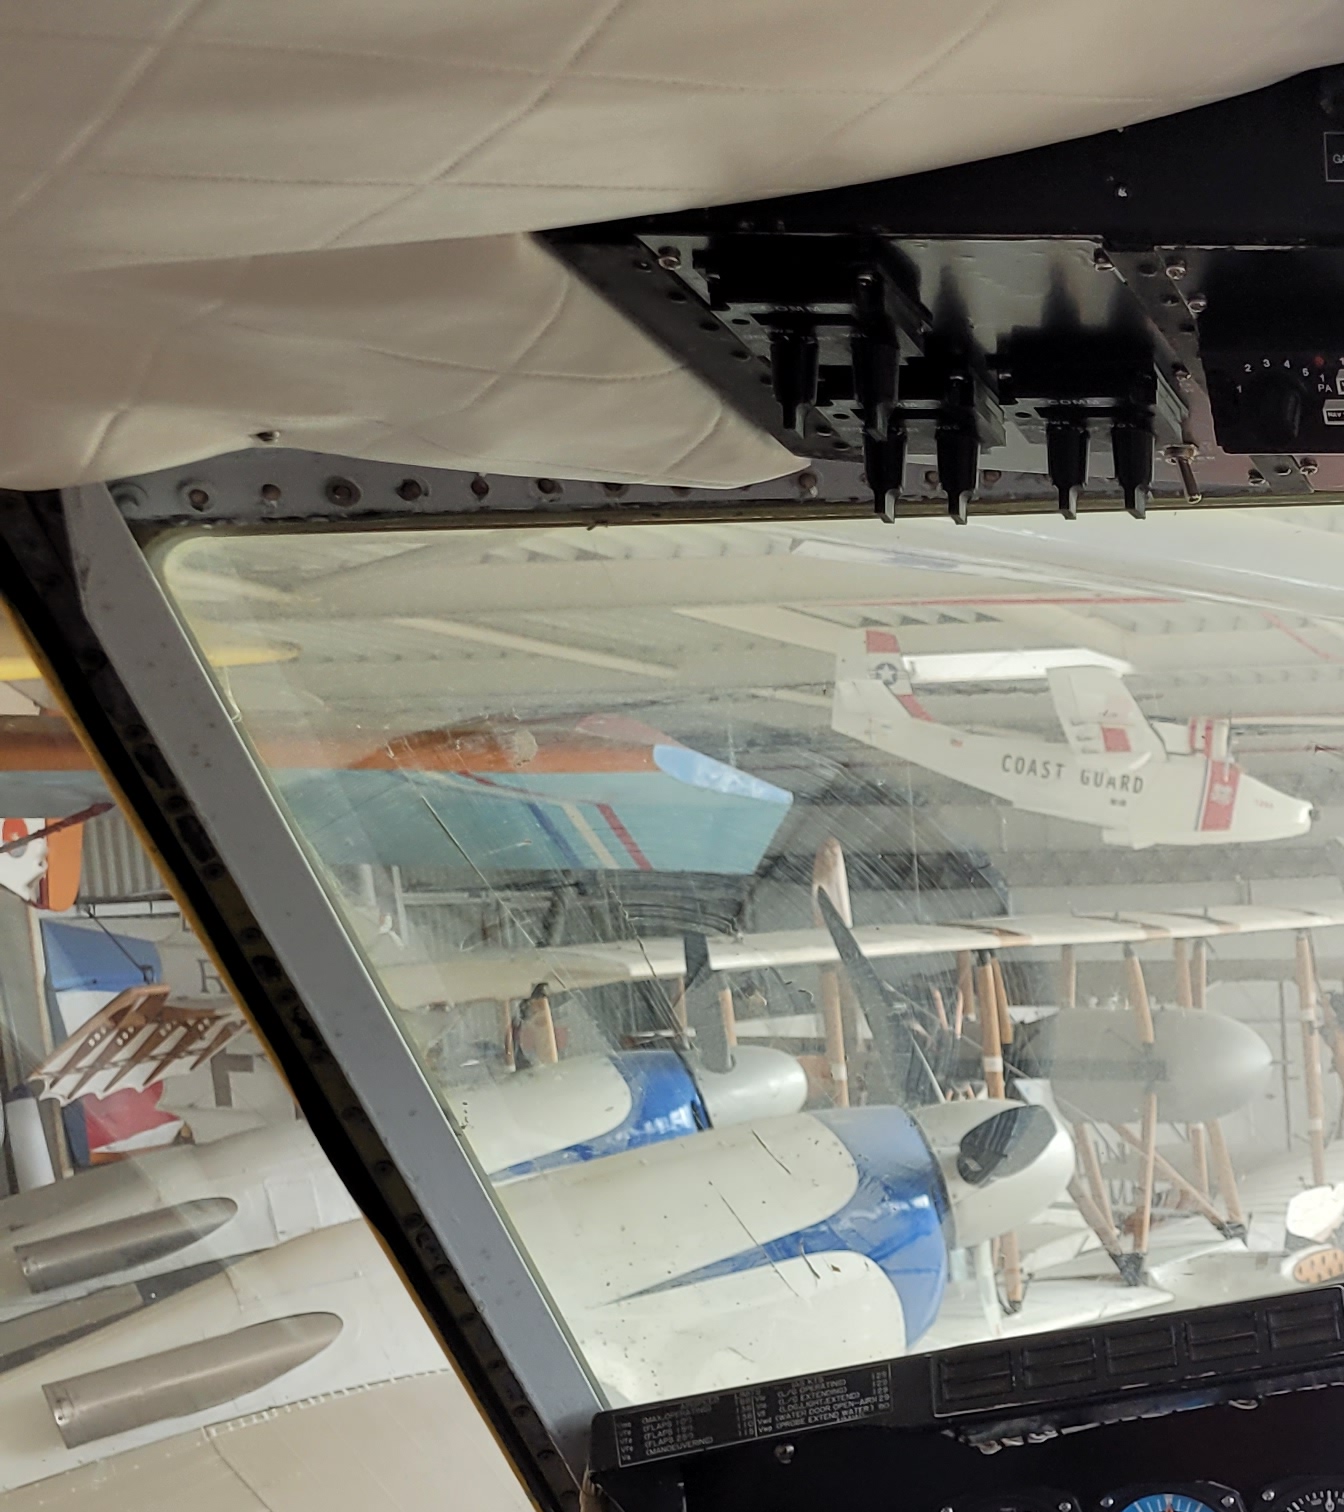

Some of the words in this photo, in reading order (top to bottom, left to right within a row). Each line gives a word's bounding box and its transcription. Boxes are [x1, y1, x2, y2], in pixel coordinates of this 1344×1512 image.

[1317, 383, 1332, 393] PA
[1002, 754, 1065, 780] COAST
[1080, 769, 1144, 794] GUARD
